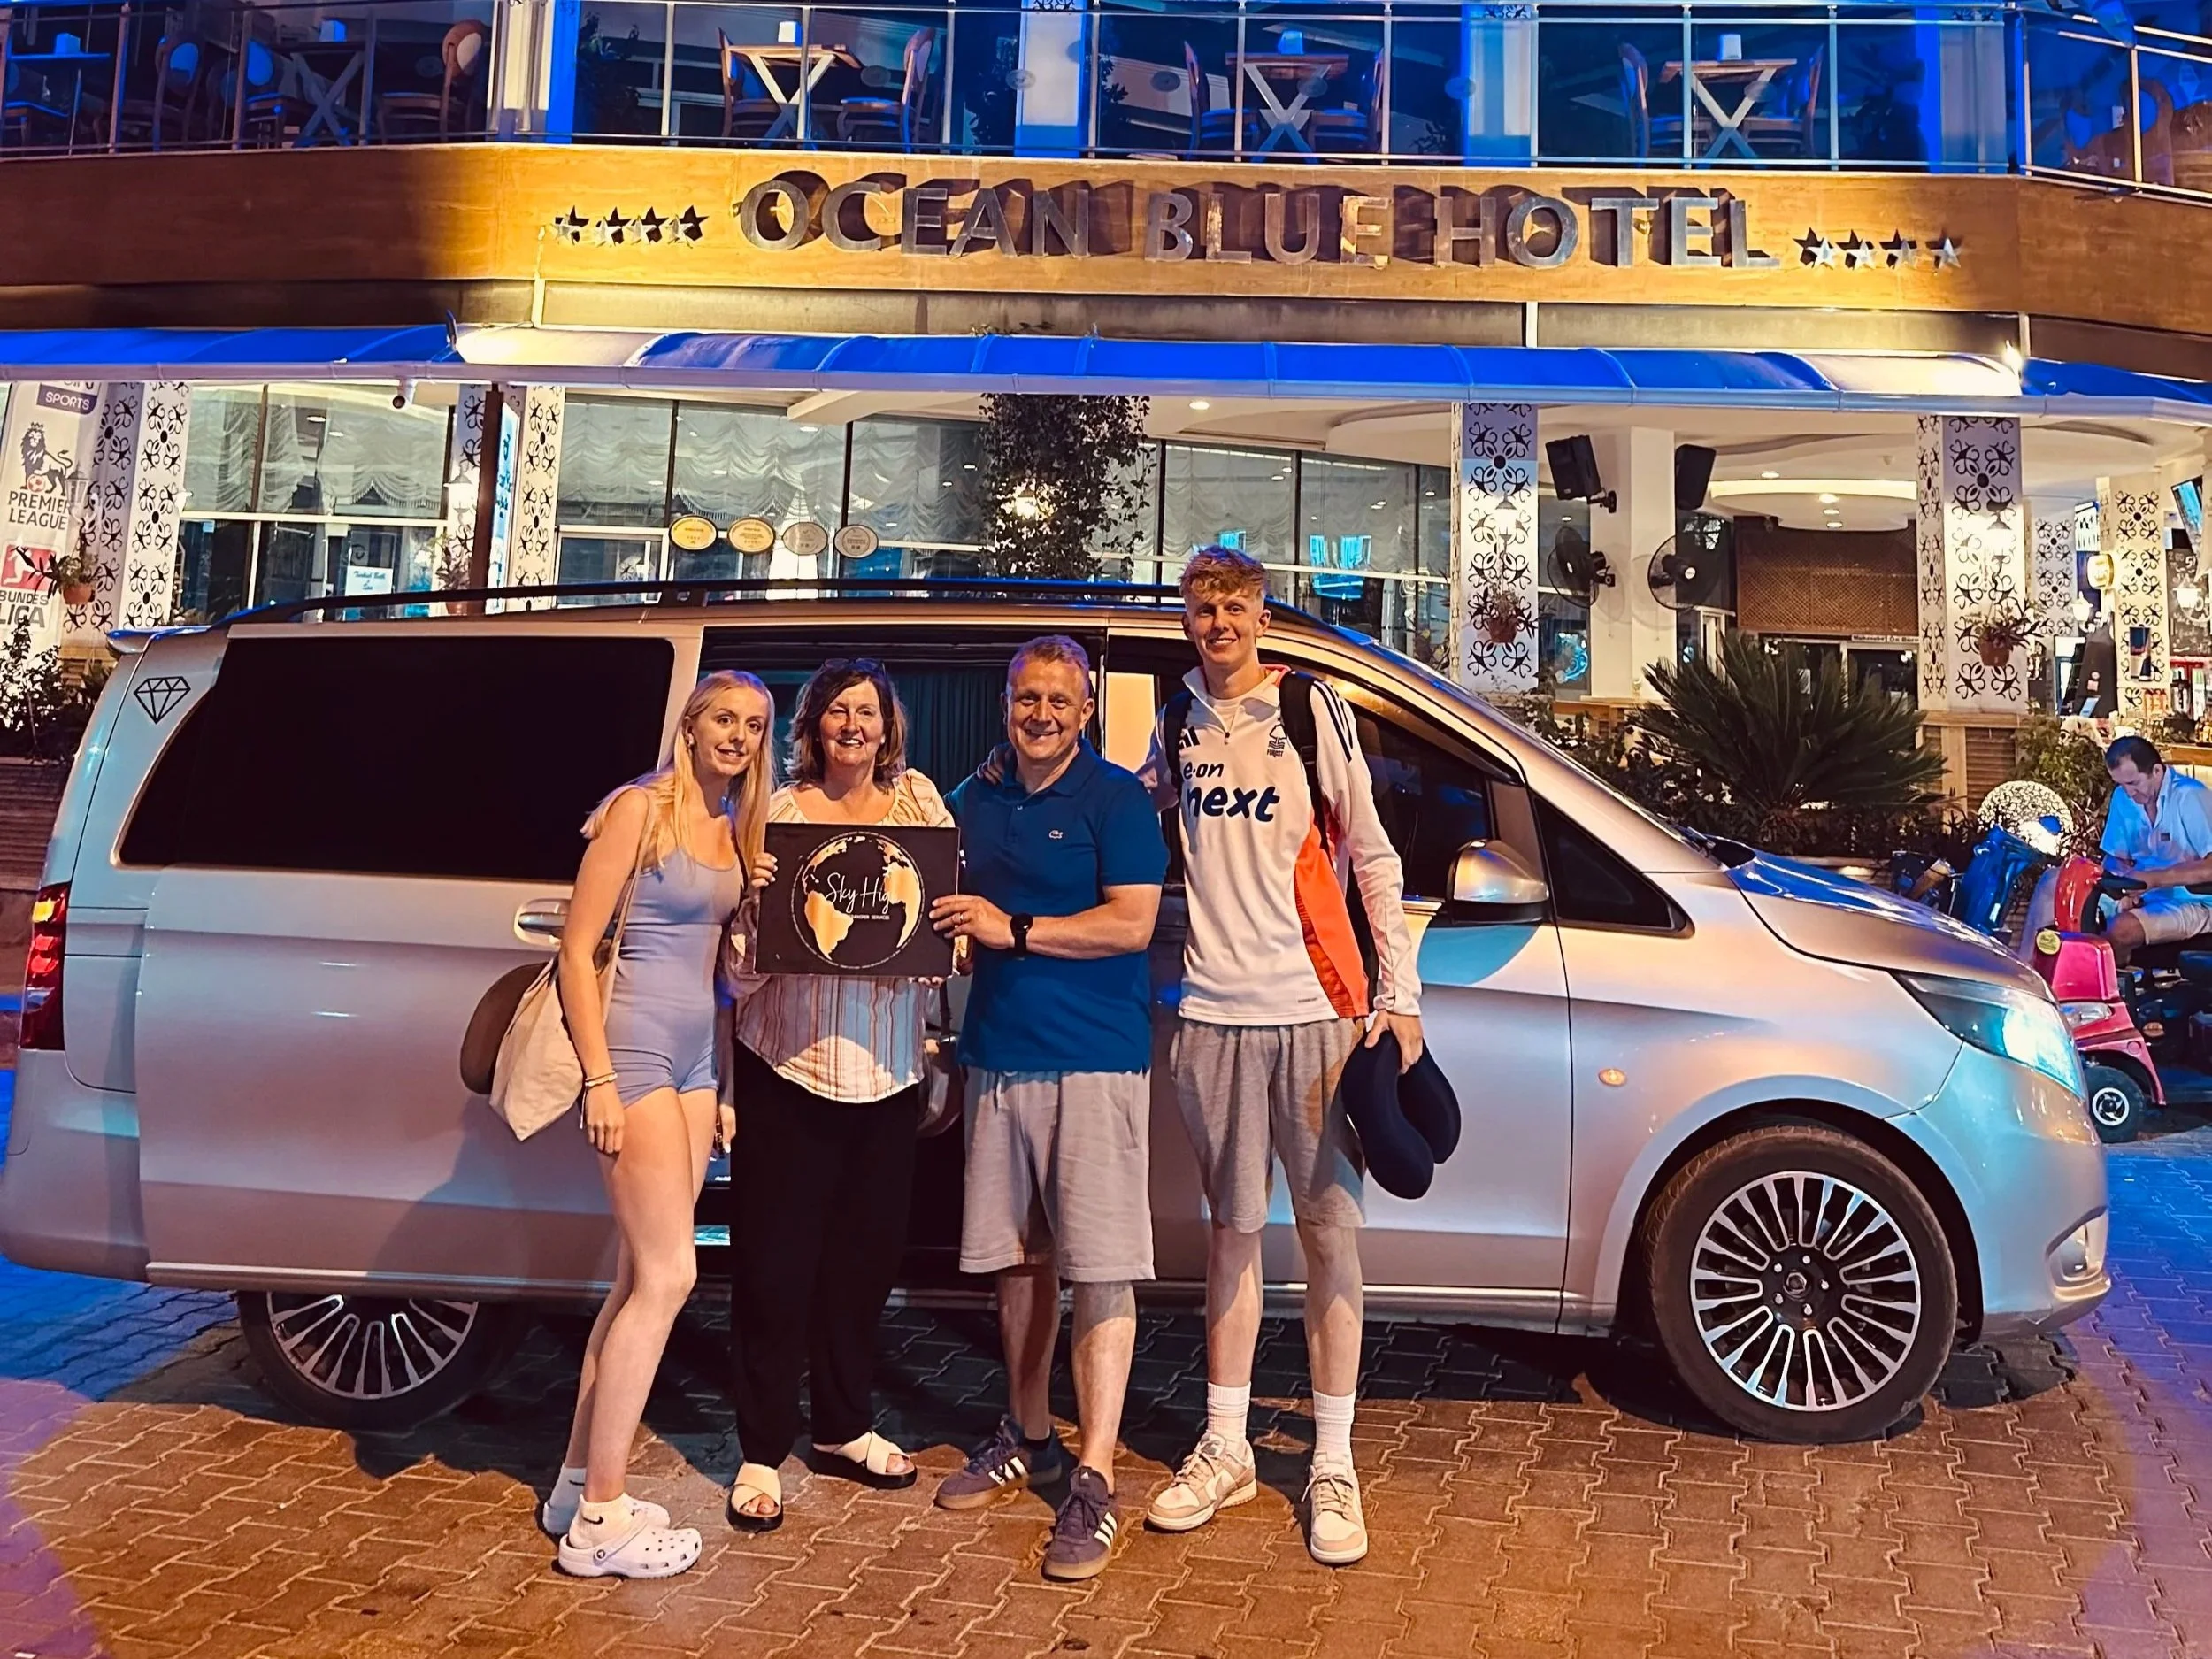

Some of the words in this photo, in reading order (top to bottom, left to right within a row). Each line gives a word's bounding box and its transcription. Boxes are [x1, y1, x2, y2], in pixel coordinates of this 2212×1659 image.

[740, 179, 1091, 257] OCEAN
[1145, 192, 1390, 267] BLUE
[1434, 196, 1780, 269] HOTEL
[45, 391, 90, 411] SPORTS
[8, 508, 67, 530] LEAGUE
[0, 589, 49, 605] BUNDES
[1187, 785, 1280, 823] next
[825, 872, 858, 913] Sky
[860, 876, 891, 915] Hig
